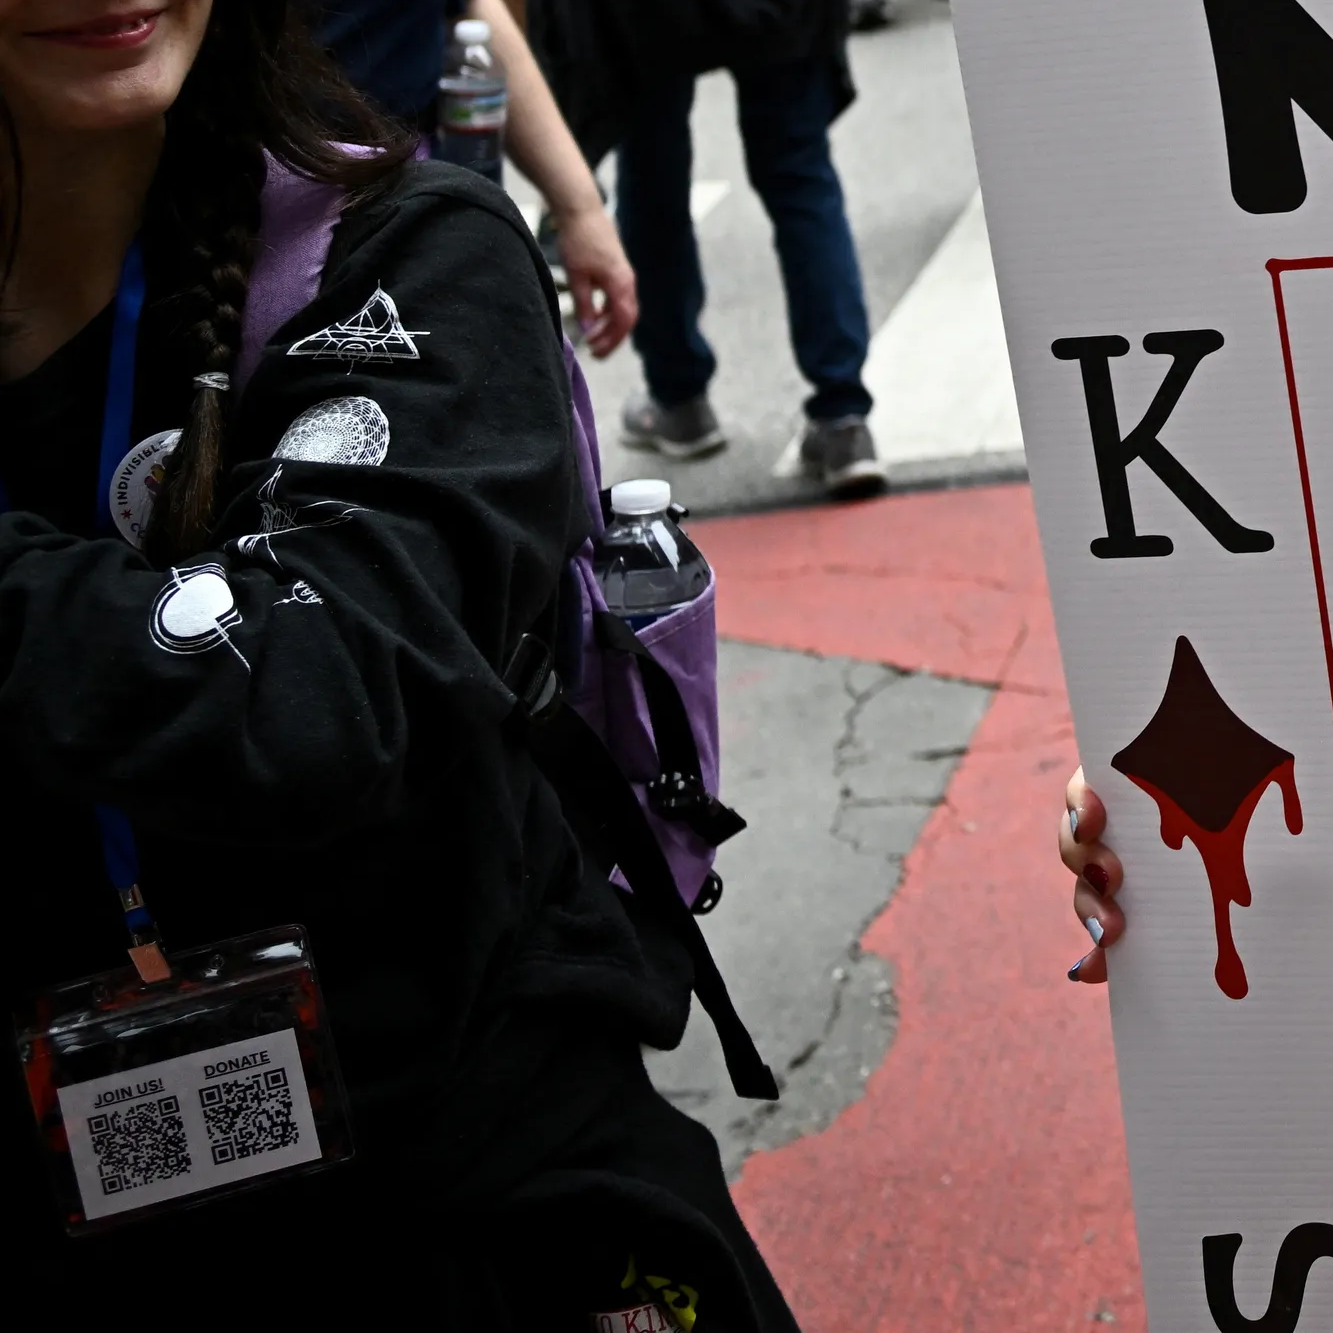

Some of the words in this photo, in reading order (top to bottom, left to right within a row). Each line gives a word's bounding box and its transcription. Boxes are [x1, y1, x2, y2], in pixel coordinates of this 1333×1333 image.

[1050, 328, 1275, 560] K
[203, 1050, 270, 1078] DONATE
[94, 1085, 134, 1108] JOIN
[137, 1078, 164, 1097] US!
